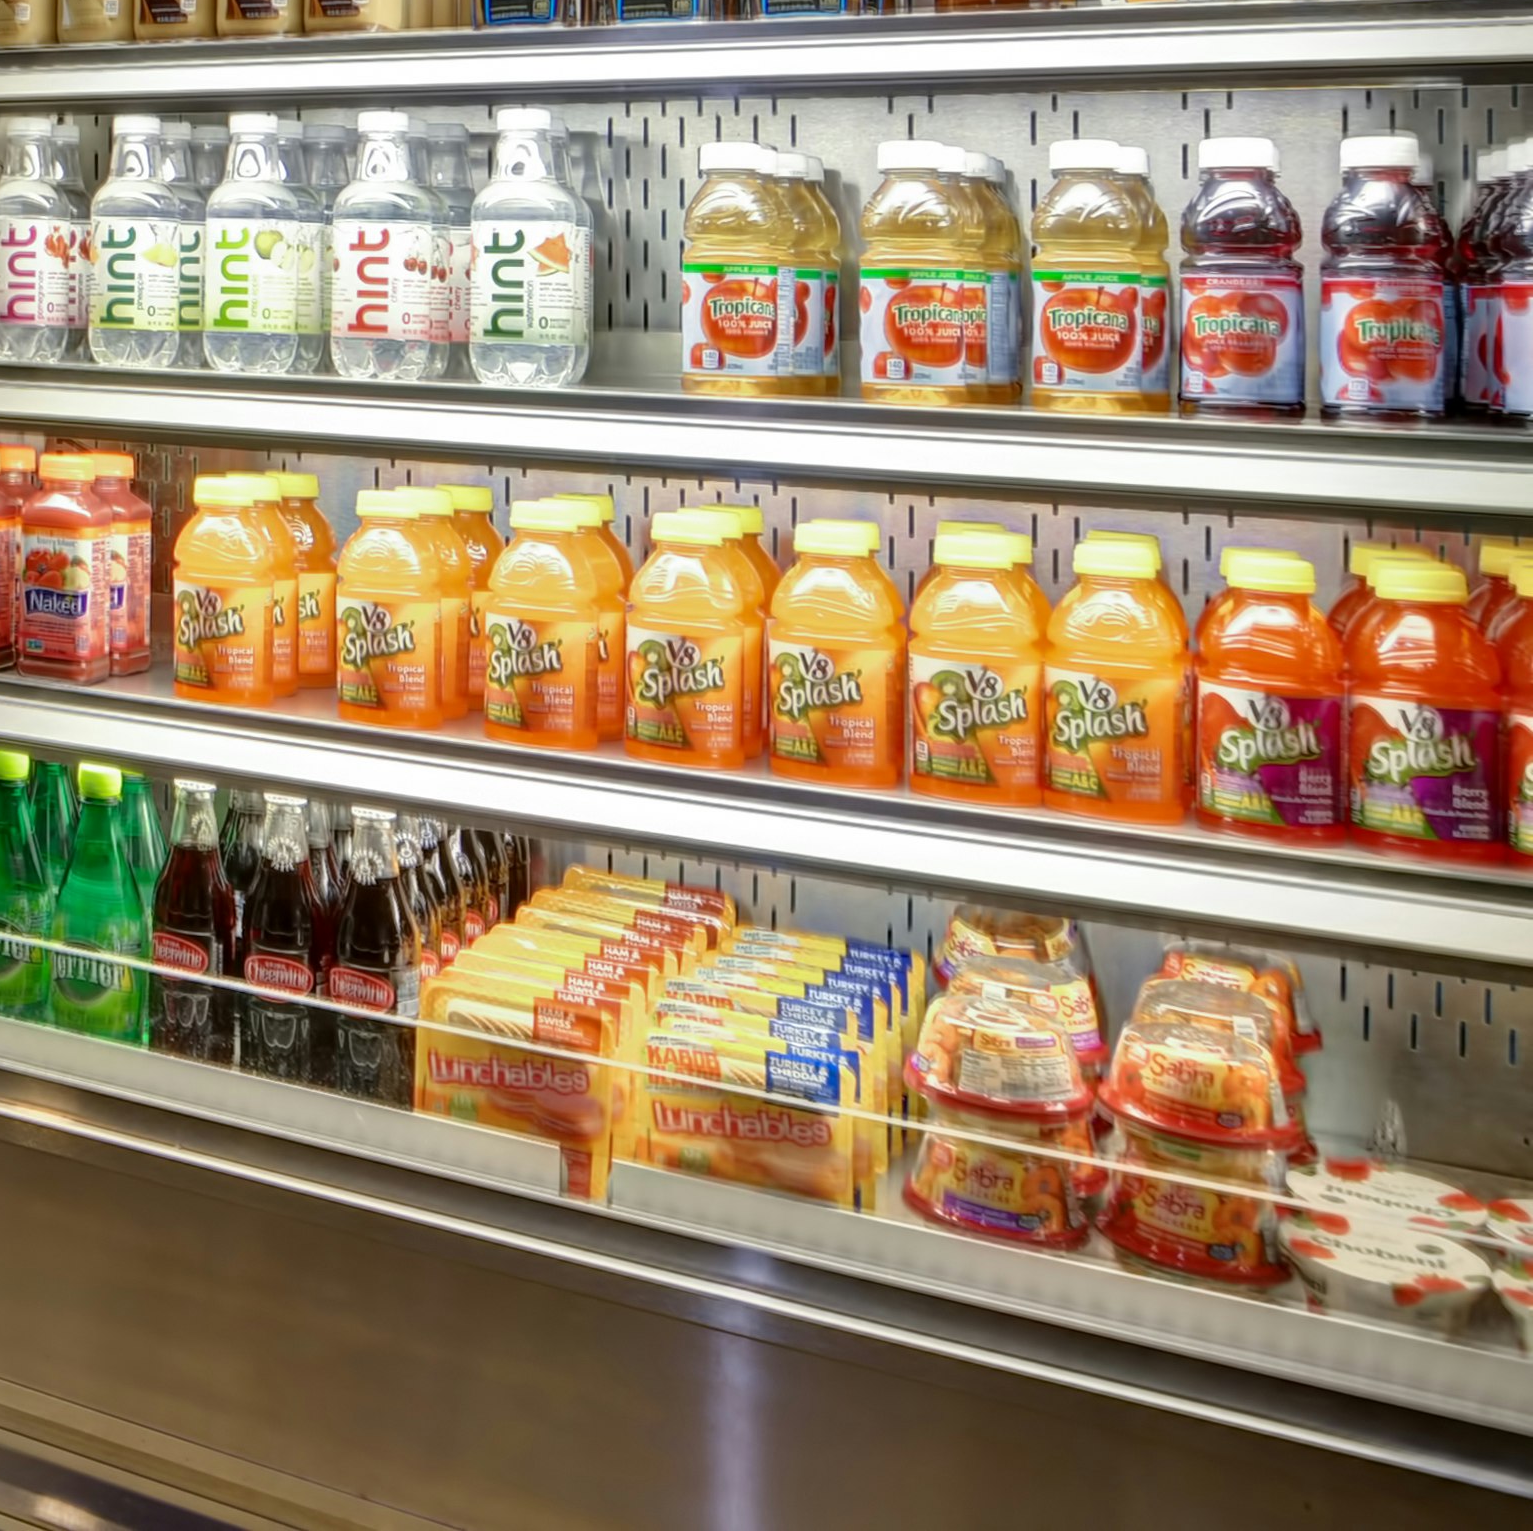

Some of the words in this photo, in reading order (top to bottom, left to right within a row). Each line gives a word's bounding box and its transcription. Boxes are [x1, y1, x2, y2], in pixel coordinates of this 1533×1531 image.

[0, 223, 37, 322] hint
[99, 225, 137, 325] hint
[213, 226, 250, 328] hint
[347, 227, 390, 334] hint
[483, 228, 525, 338] hint
[710, 296, 776, 319] Tropicana
[893, 303, 962, 326] Tropicana
[1048, 306, 1128, 330] Tropicana
[1194, 313, 1281, 338] Tropicana
[31, 589, 85, 615] Naked
[195, 590, 217, 617] V8
[179, 602, 244, 643] Splash
[361, 605, 390, 632] V8
[342, 621, 415, 662] Splash
[507, 622, 534, 650] V8
[489, 639, 562, 681] Splash
[666, 639, 697, 669] V8
[799, 653, 831, 682] V8
[642, 661, 724, 700] Splash
[778, 672, 861, 714] Splash
[964, 669, 999, 699] V8
[1078, 679, 1111, 711] V8
[937, 693, 1027, 734] Splash
[1055, 703, 1146, 743] Splash
[1247, 698, 1284, 730] V8
[1399, 709, 1439, 739] V8
[1219, 727, 1319, 766] Splash
[1371, 736, 1475, 780] Splash
[781, 1002, 823, 1019] TURKEY
[429, 1051, 589, 1095] Lunchables
[647, 1044, 720, 1070] KABOB
[769, 1055, 817, 1075] TURKEY
[1151, 1052, 1215, 1090] Sabra
[769, 1066, 828, 1085] CHEDDAR
[653, 1101, 833, 1147] Lunchables
